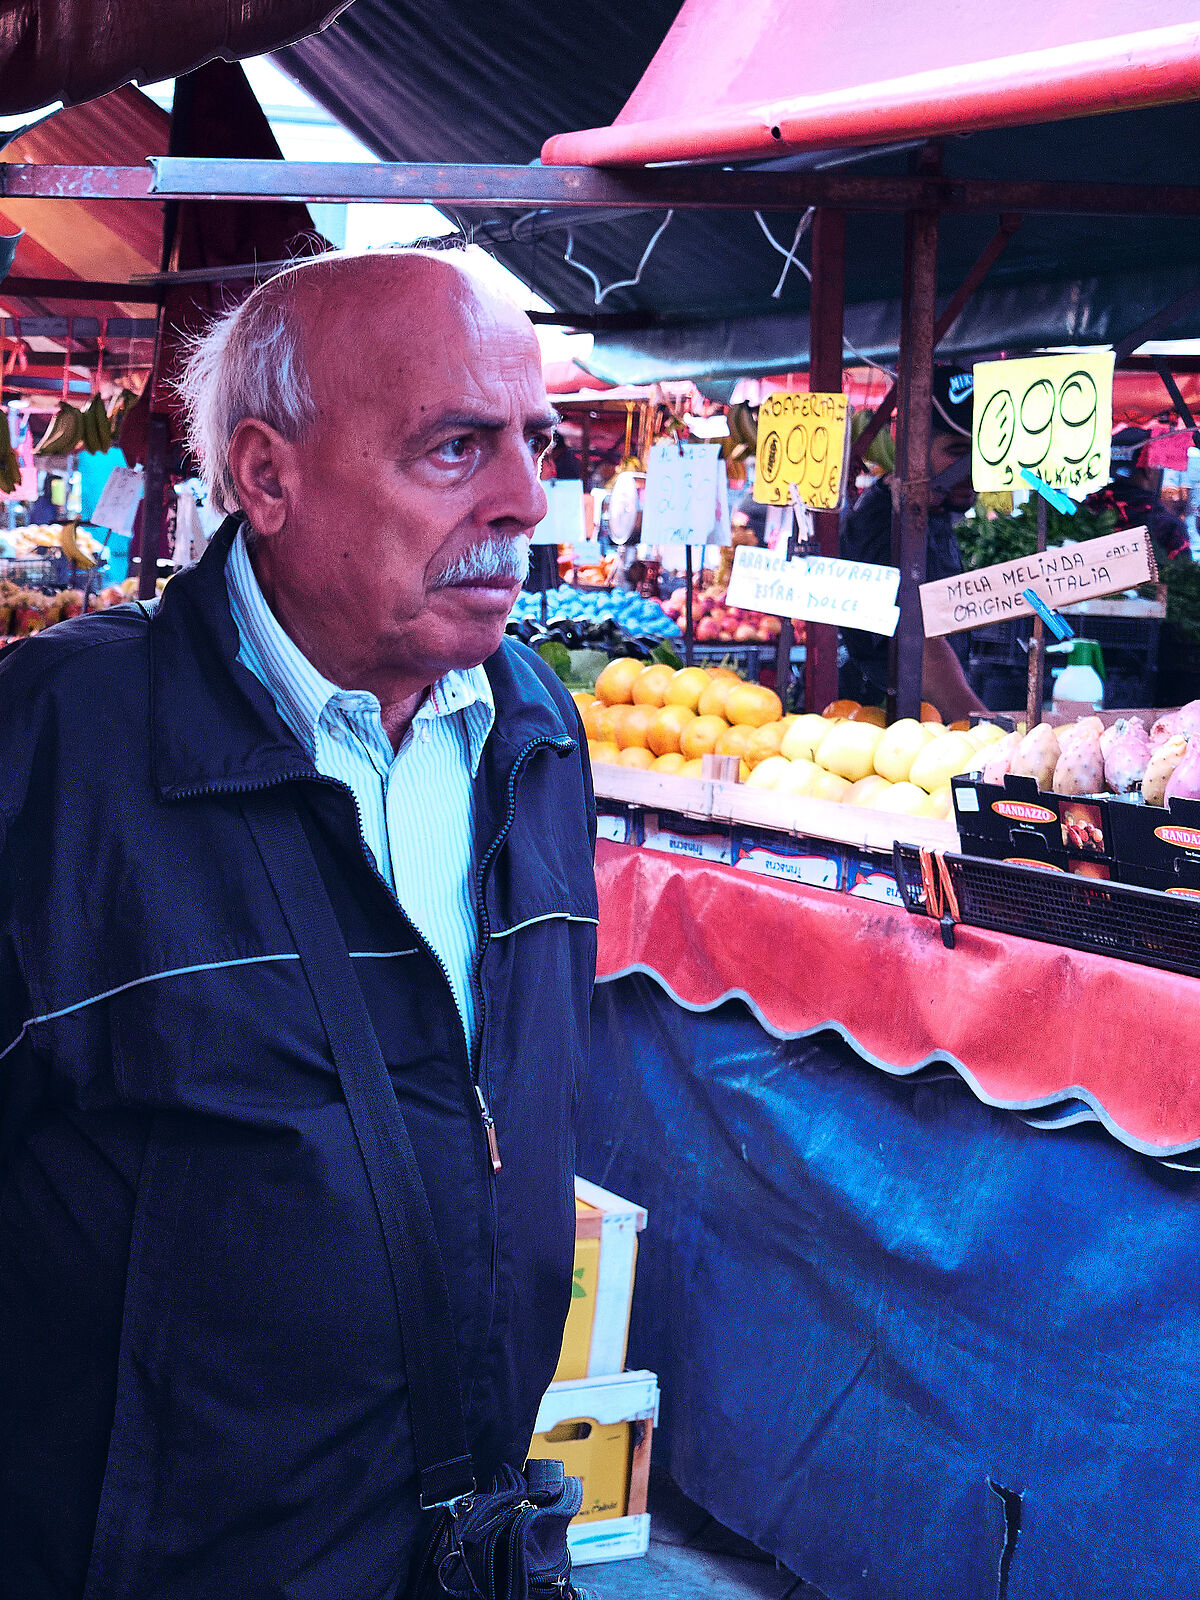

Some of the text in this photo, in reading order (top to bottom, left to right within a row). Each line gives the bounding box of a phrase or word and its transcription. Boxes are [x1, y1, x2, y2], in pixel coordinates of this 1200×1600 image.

[949, 374, 974, 391] NIK
[804, 559, 894, 582] NATURALE
[947, 575, 992, 600] MELA
[1002, 552, 1085, 587] MELINDA
[807, 592, 859, 612] DOLCE
[953, 566, 1112, 623] ORIGINE ITALIA
[998, 803, 1051, 821] RANDAZZO
[669, 839, 703, 856] Trinacria
[765, 860, 802, 879] Trinacria
